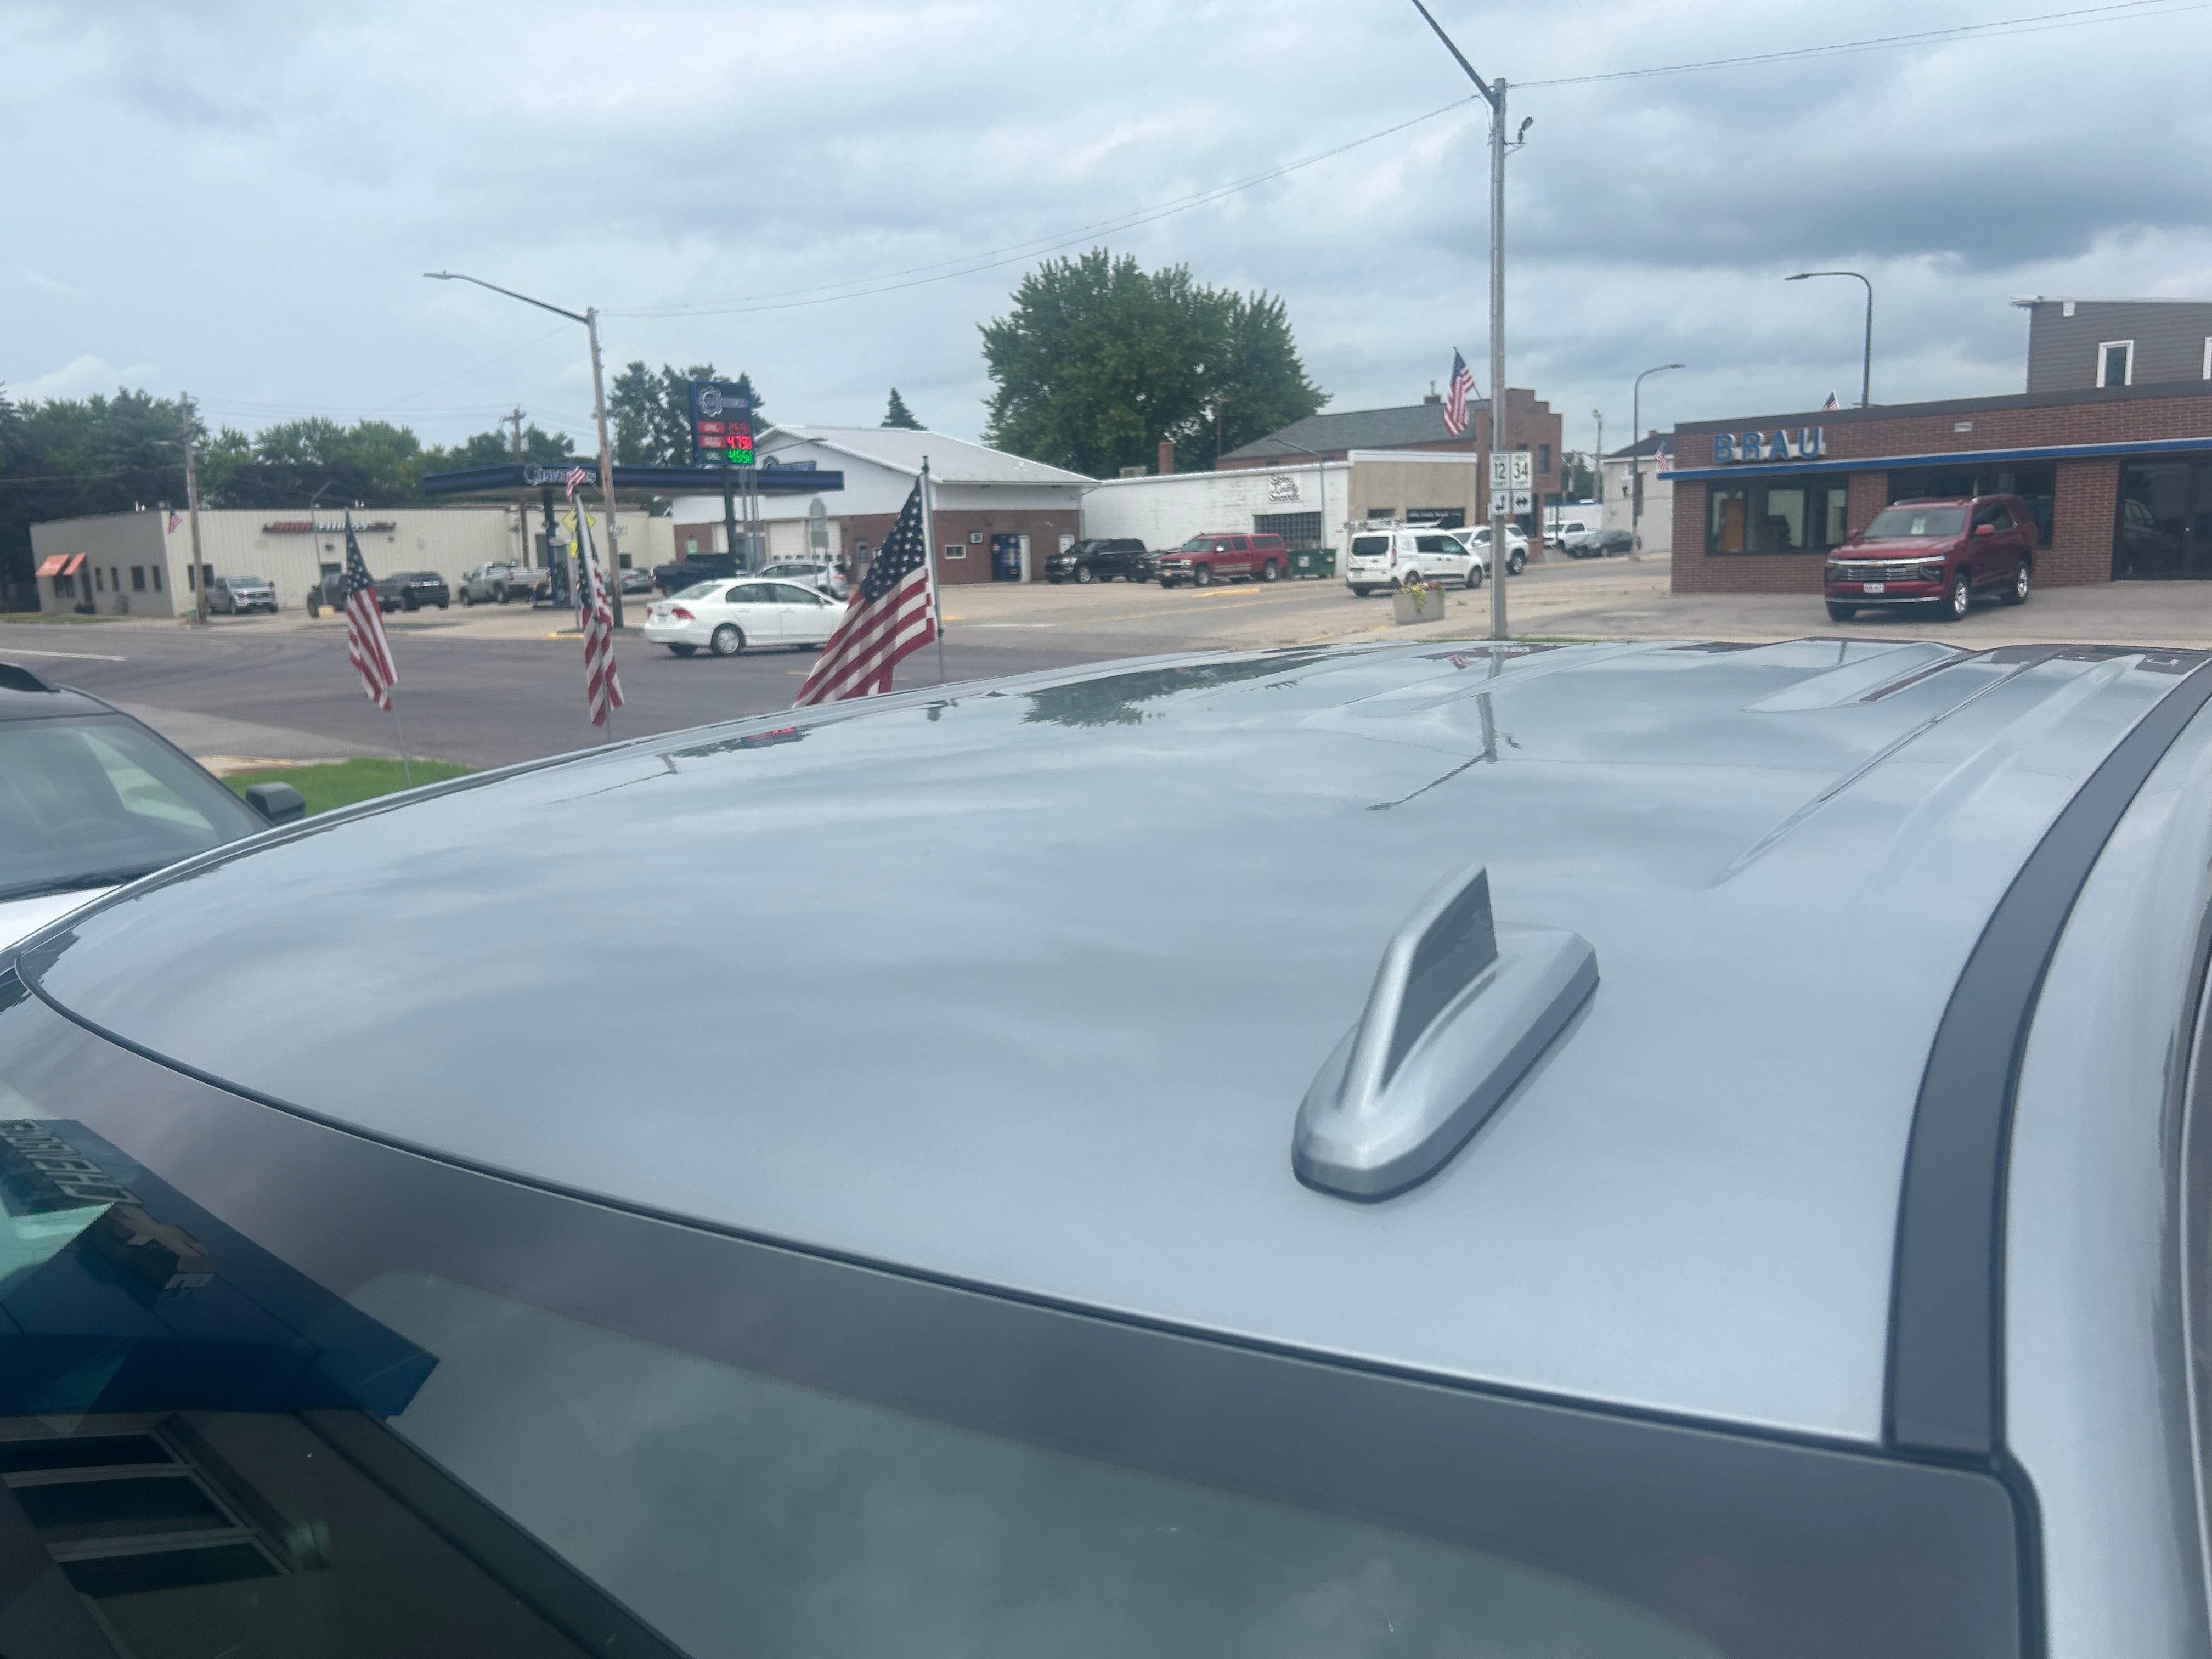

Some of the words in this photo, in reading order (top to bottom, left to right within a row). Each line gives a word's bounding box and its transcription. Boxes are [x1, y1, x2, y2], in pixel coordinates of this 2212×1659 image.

[1713, 426, 1823, 463] BRAU
[1494, 462, 1506, 480] 12
[1514, 461, 1529, 480] 34
